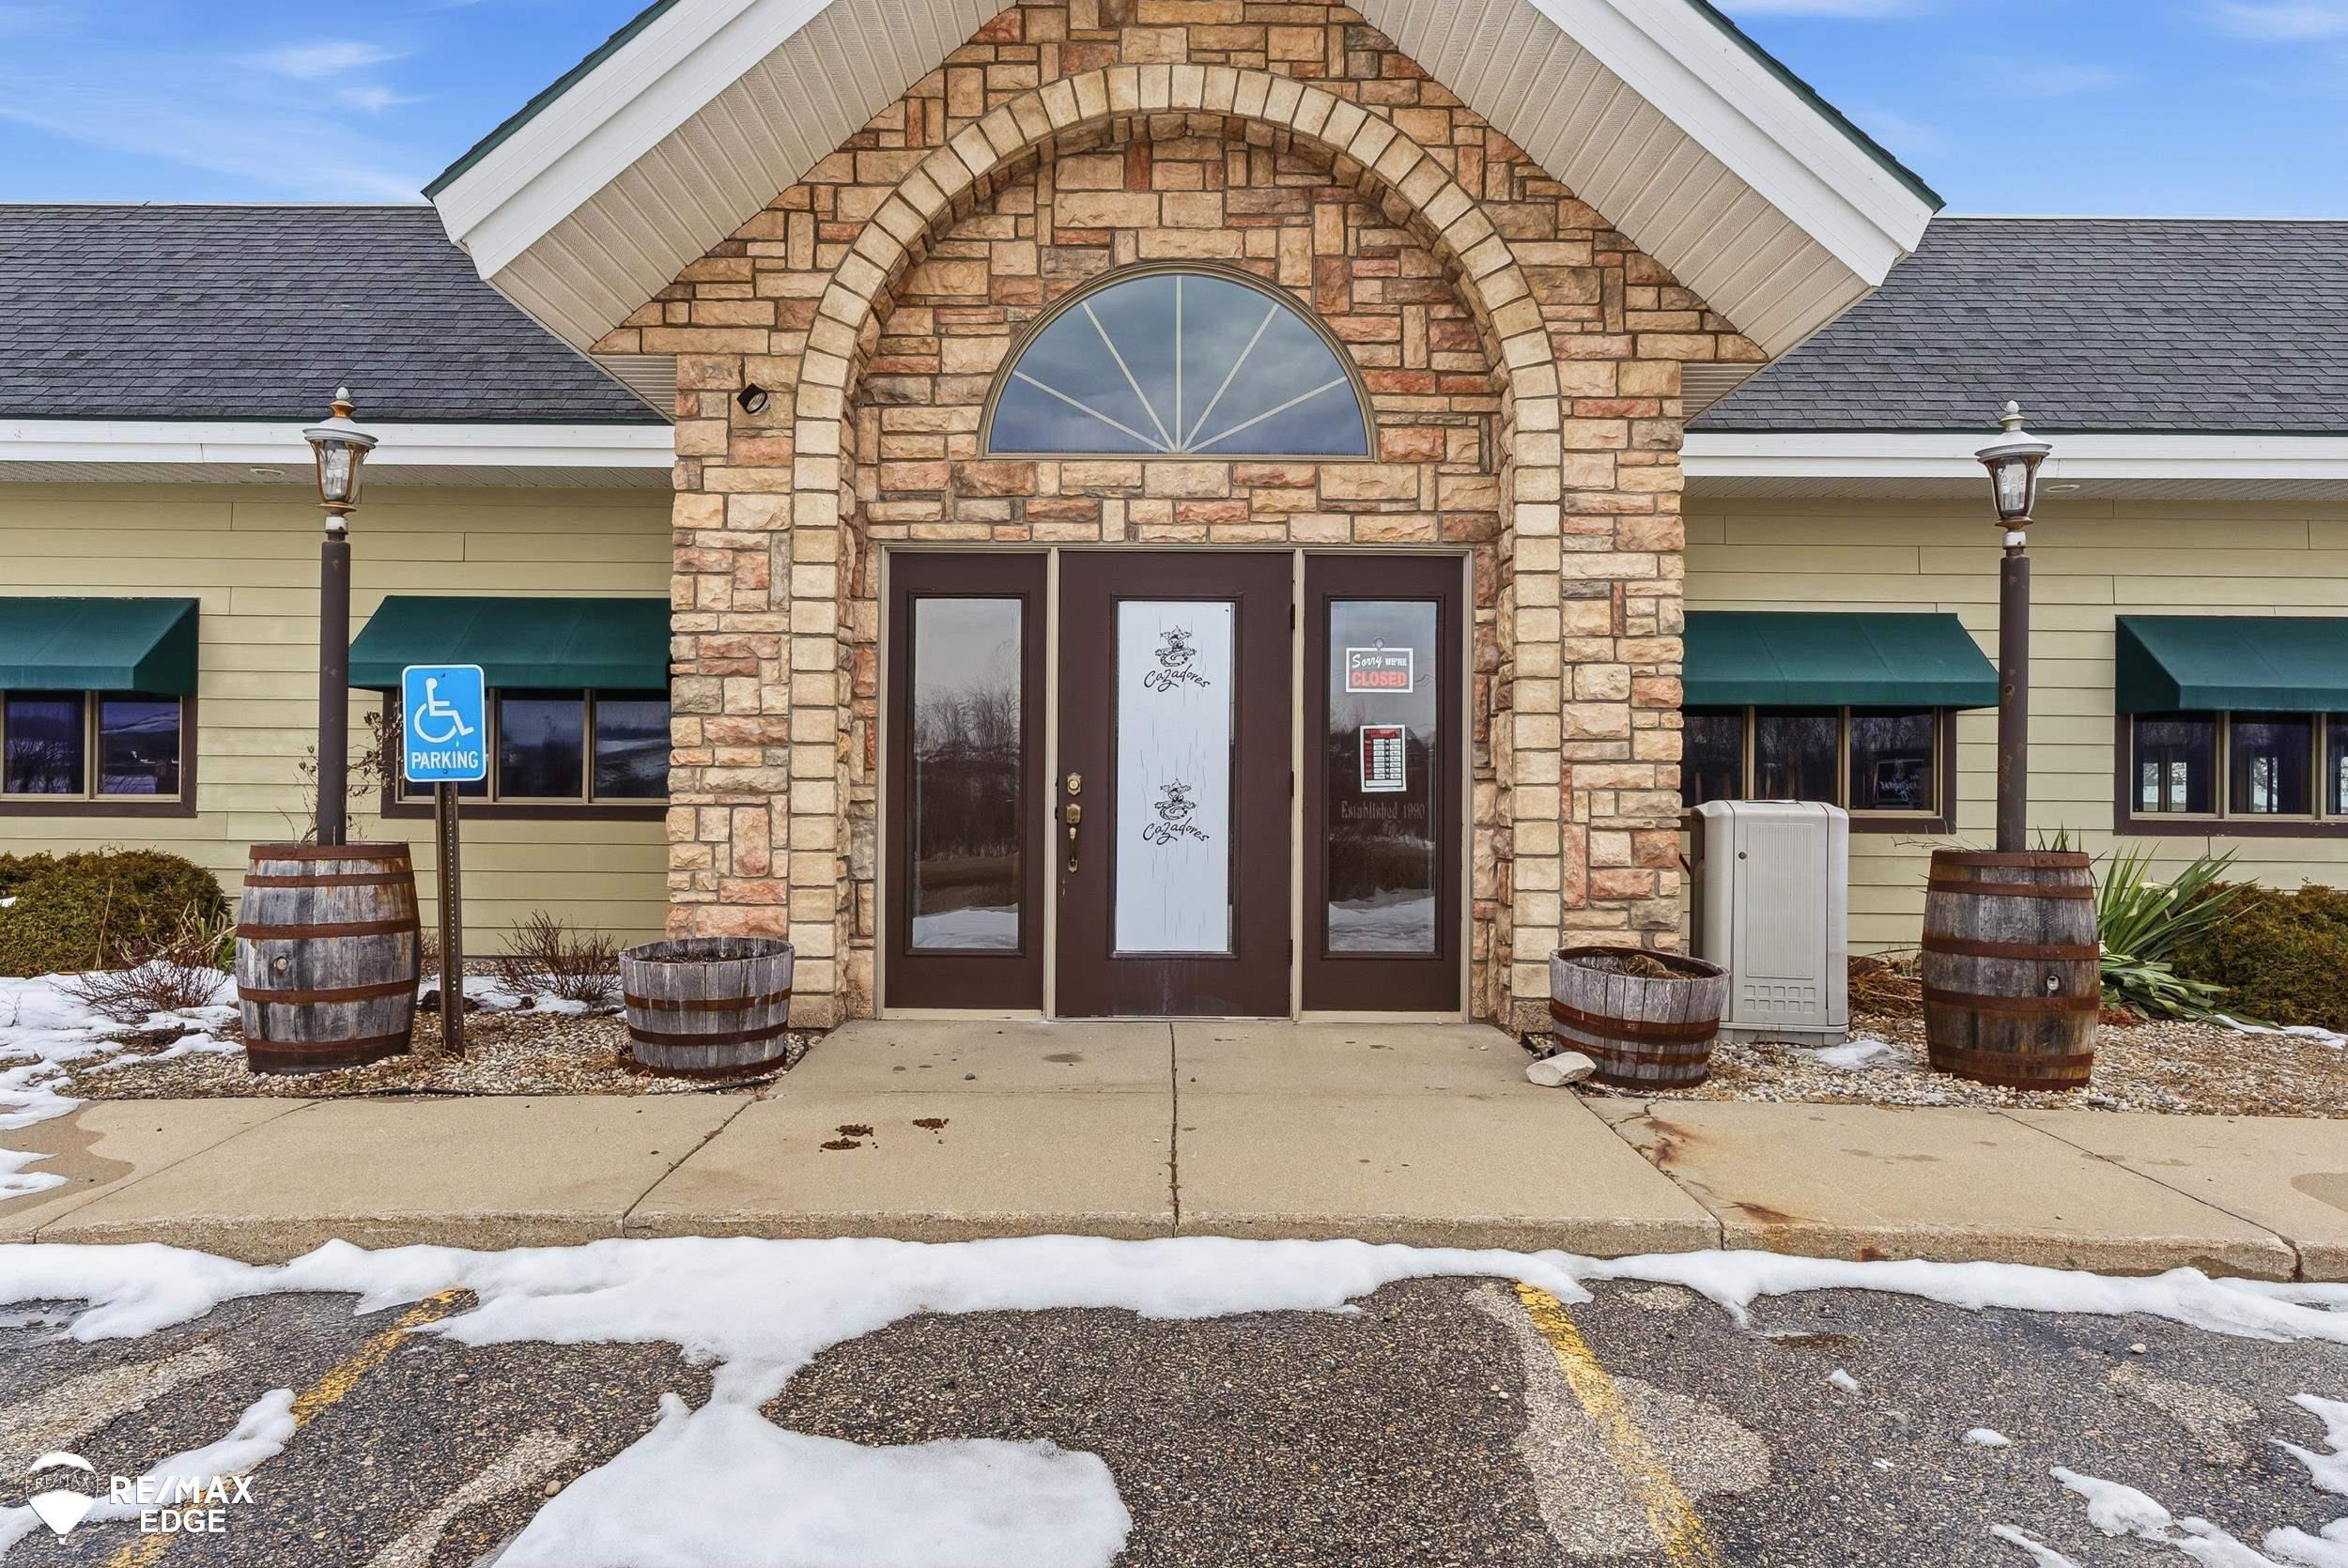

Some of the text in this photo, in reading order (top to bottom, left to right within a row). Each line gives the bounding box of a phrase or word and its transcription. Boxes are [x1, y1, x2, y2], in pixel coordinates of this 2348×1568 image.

[1352, 653, 1383, 669] Sorry
[1144, 663, 1211, 692] Cazadores
[1352, 670, 1408, 687] CLOSED
[411, 751, 479, 769] PARKING
[1341, 800, 1398, 820] Established
[1142, 816, 1210, 845] Cazadores
